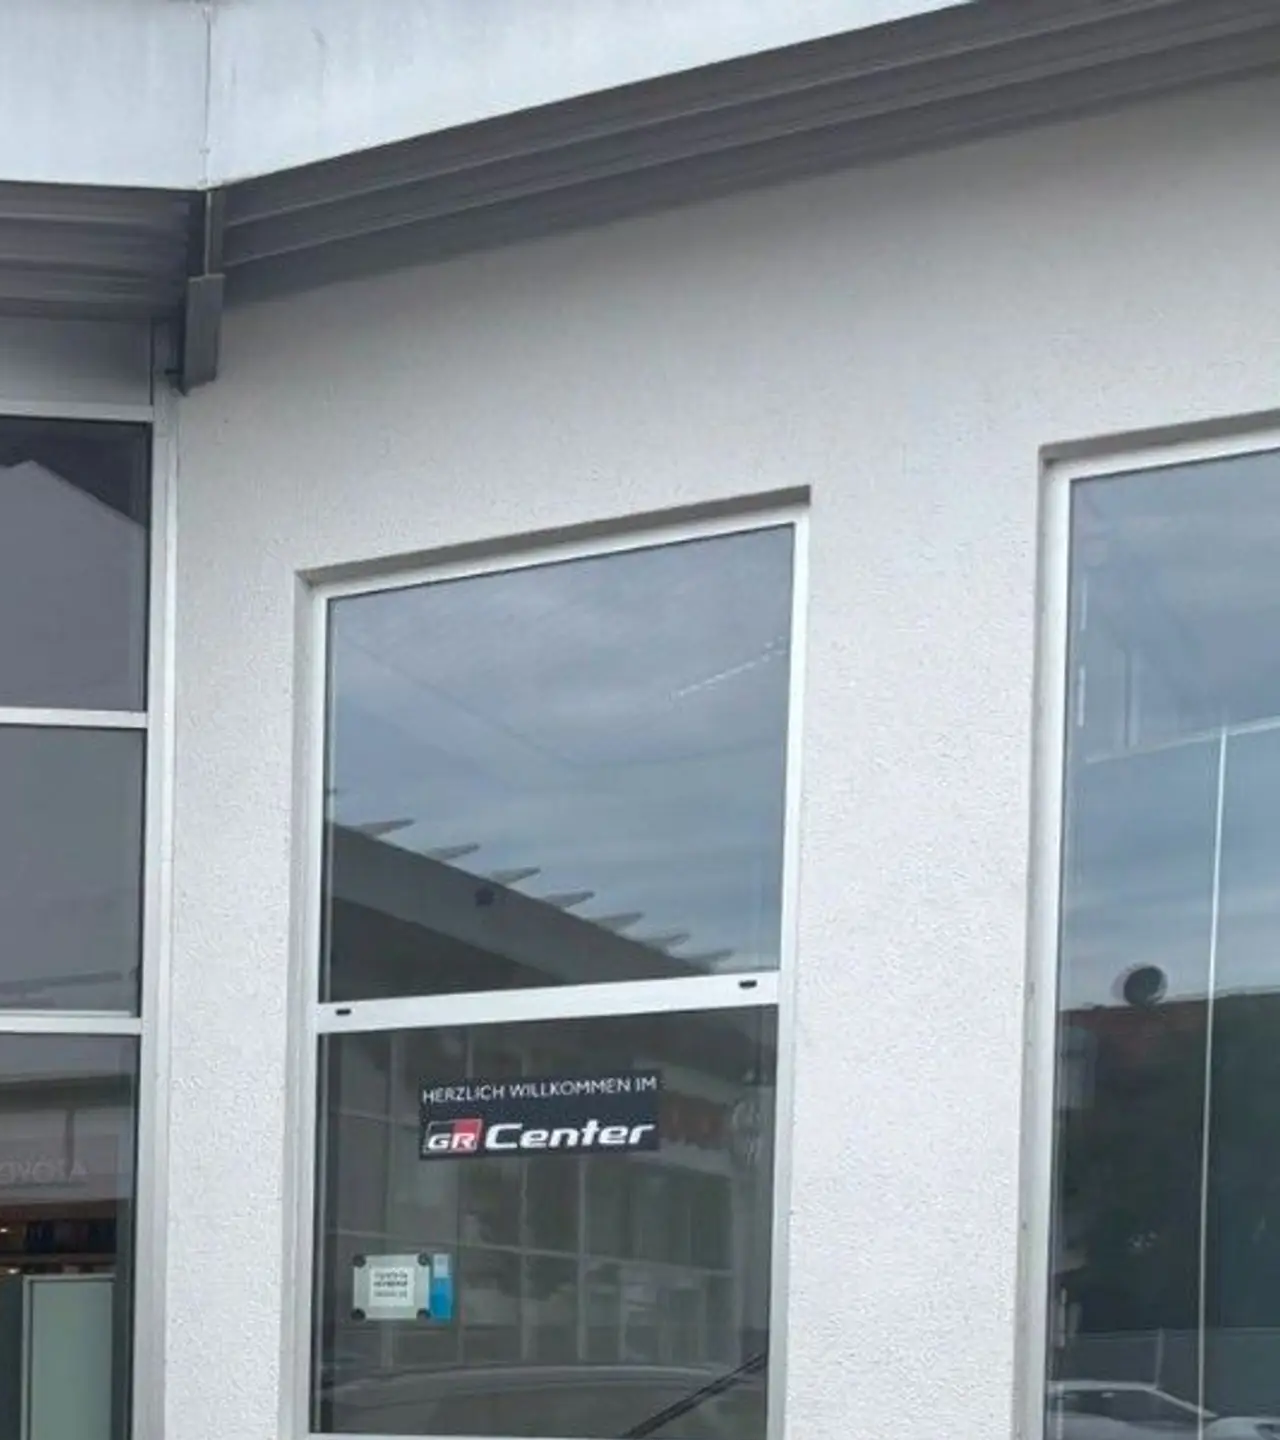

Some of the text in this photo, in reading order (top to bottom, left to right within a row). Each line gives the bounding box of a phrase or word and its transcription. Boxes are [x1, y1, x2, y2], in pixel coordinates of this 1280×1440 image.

[422, 1075, 657, 1104] HERZLICH WILLKOMMEN IM
[426, 1119, 656, 1151] GR Center
